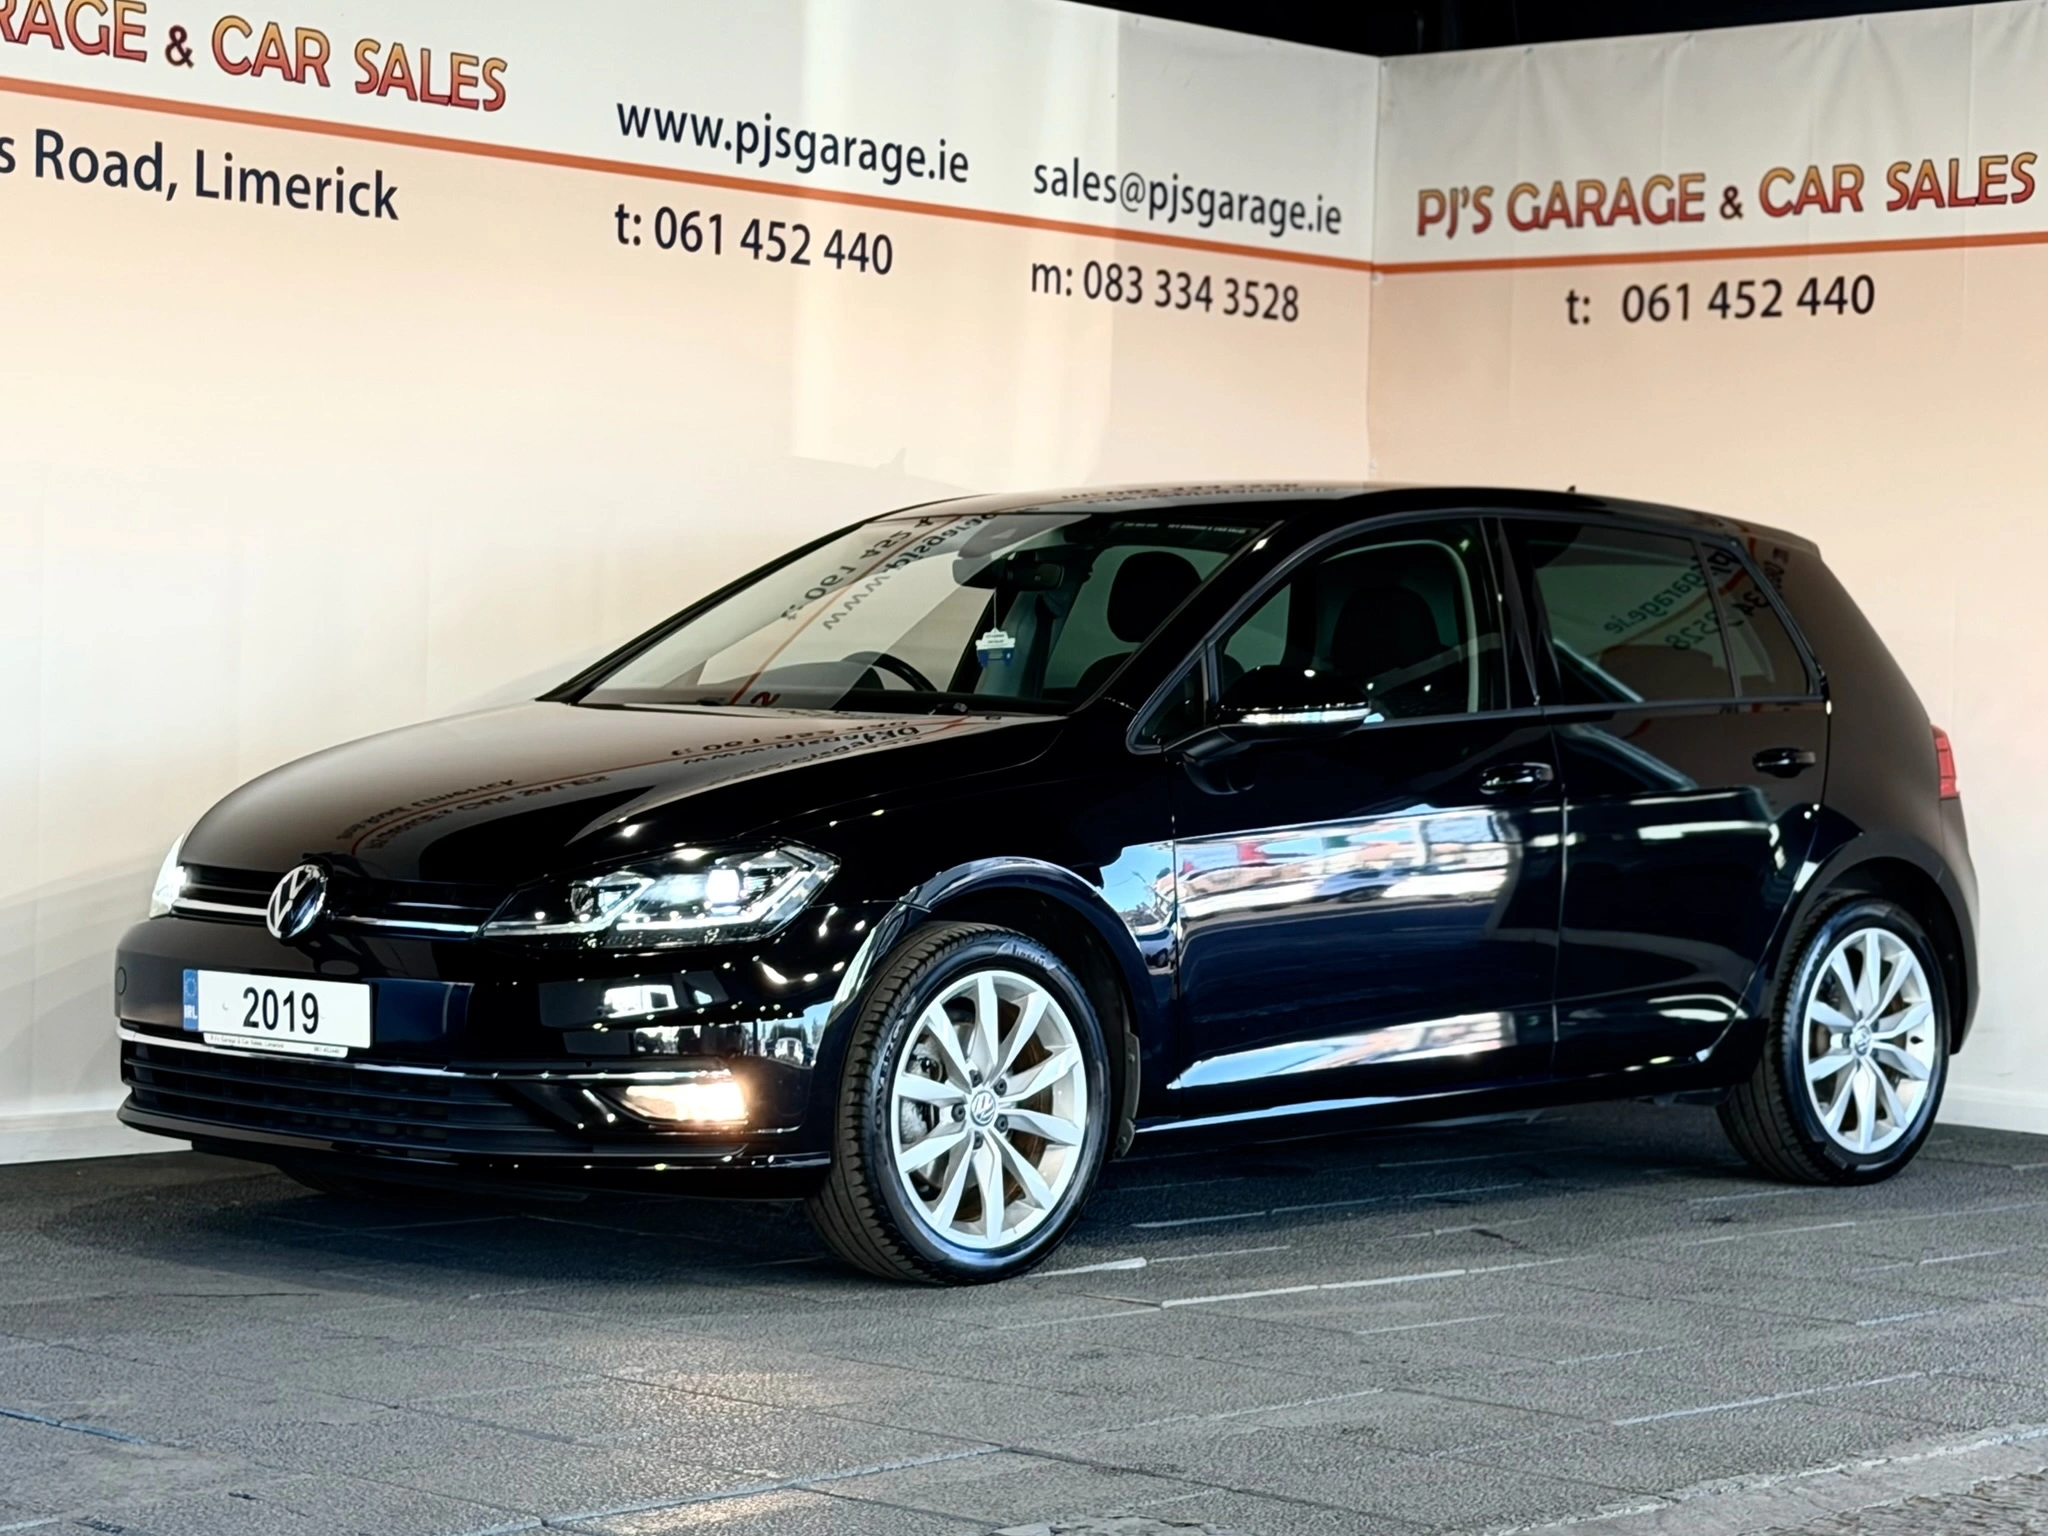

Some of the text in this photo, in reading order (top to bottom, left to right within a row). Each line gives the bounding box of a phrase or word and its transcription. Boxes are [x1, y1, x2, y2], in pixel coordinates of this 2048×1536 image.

[164, 25, 195, 68] &
[212, 15, 331, 87] CAR
[353, 38, 509, 112] SALES
[36, 128, 178, 202] Road,
[196, 149, 399, 221] Limerick
[615, 102, 969, 186] www.pjsgarage.ie
[1033, 157, 1342, 238] sales@pjsgarage.ie
[1416, 151, 2038, 239] PJ'S GARAGE & CAR SALES
[614, 203, 893, 276] t: 061 452 440
[1031, 261, 1299, 323] m: 083 334 3528
[1565, 274, 1876, 325] t: 061 452 440
[242, 986, 319, 1035] 2019
